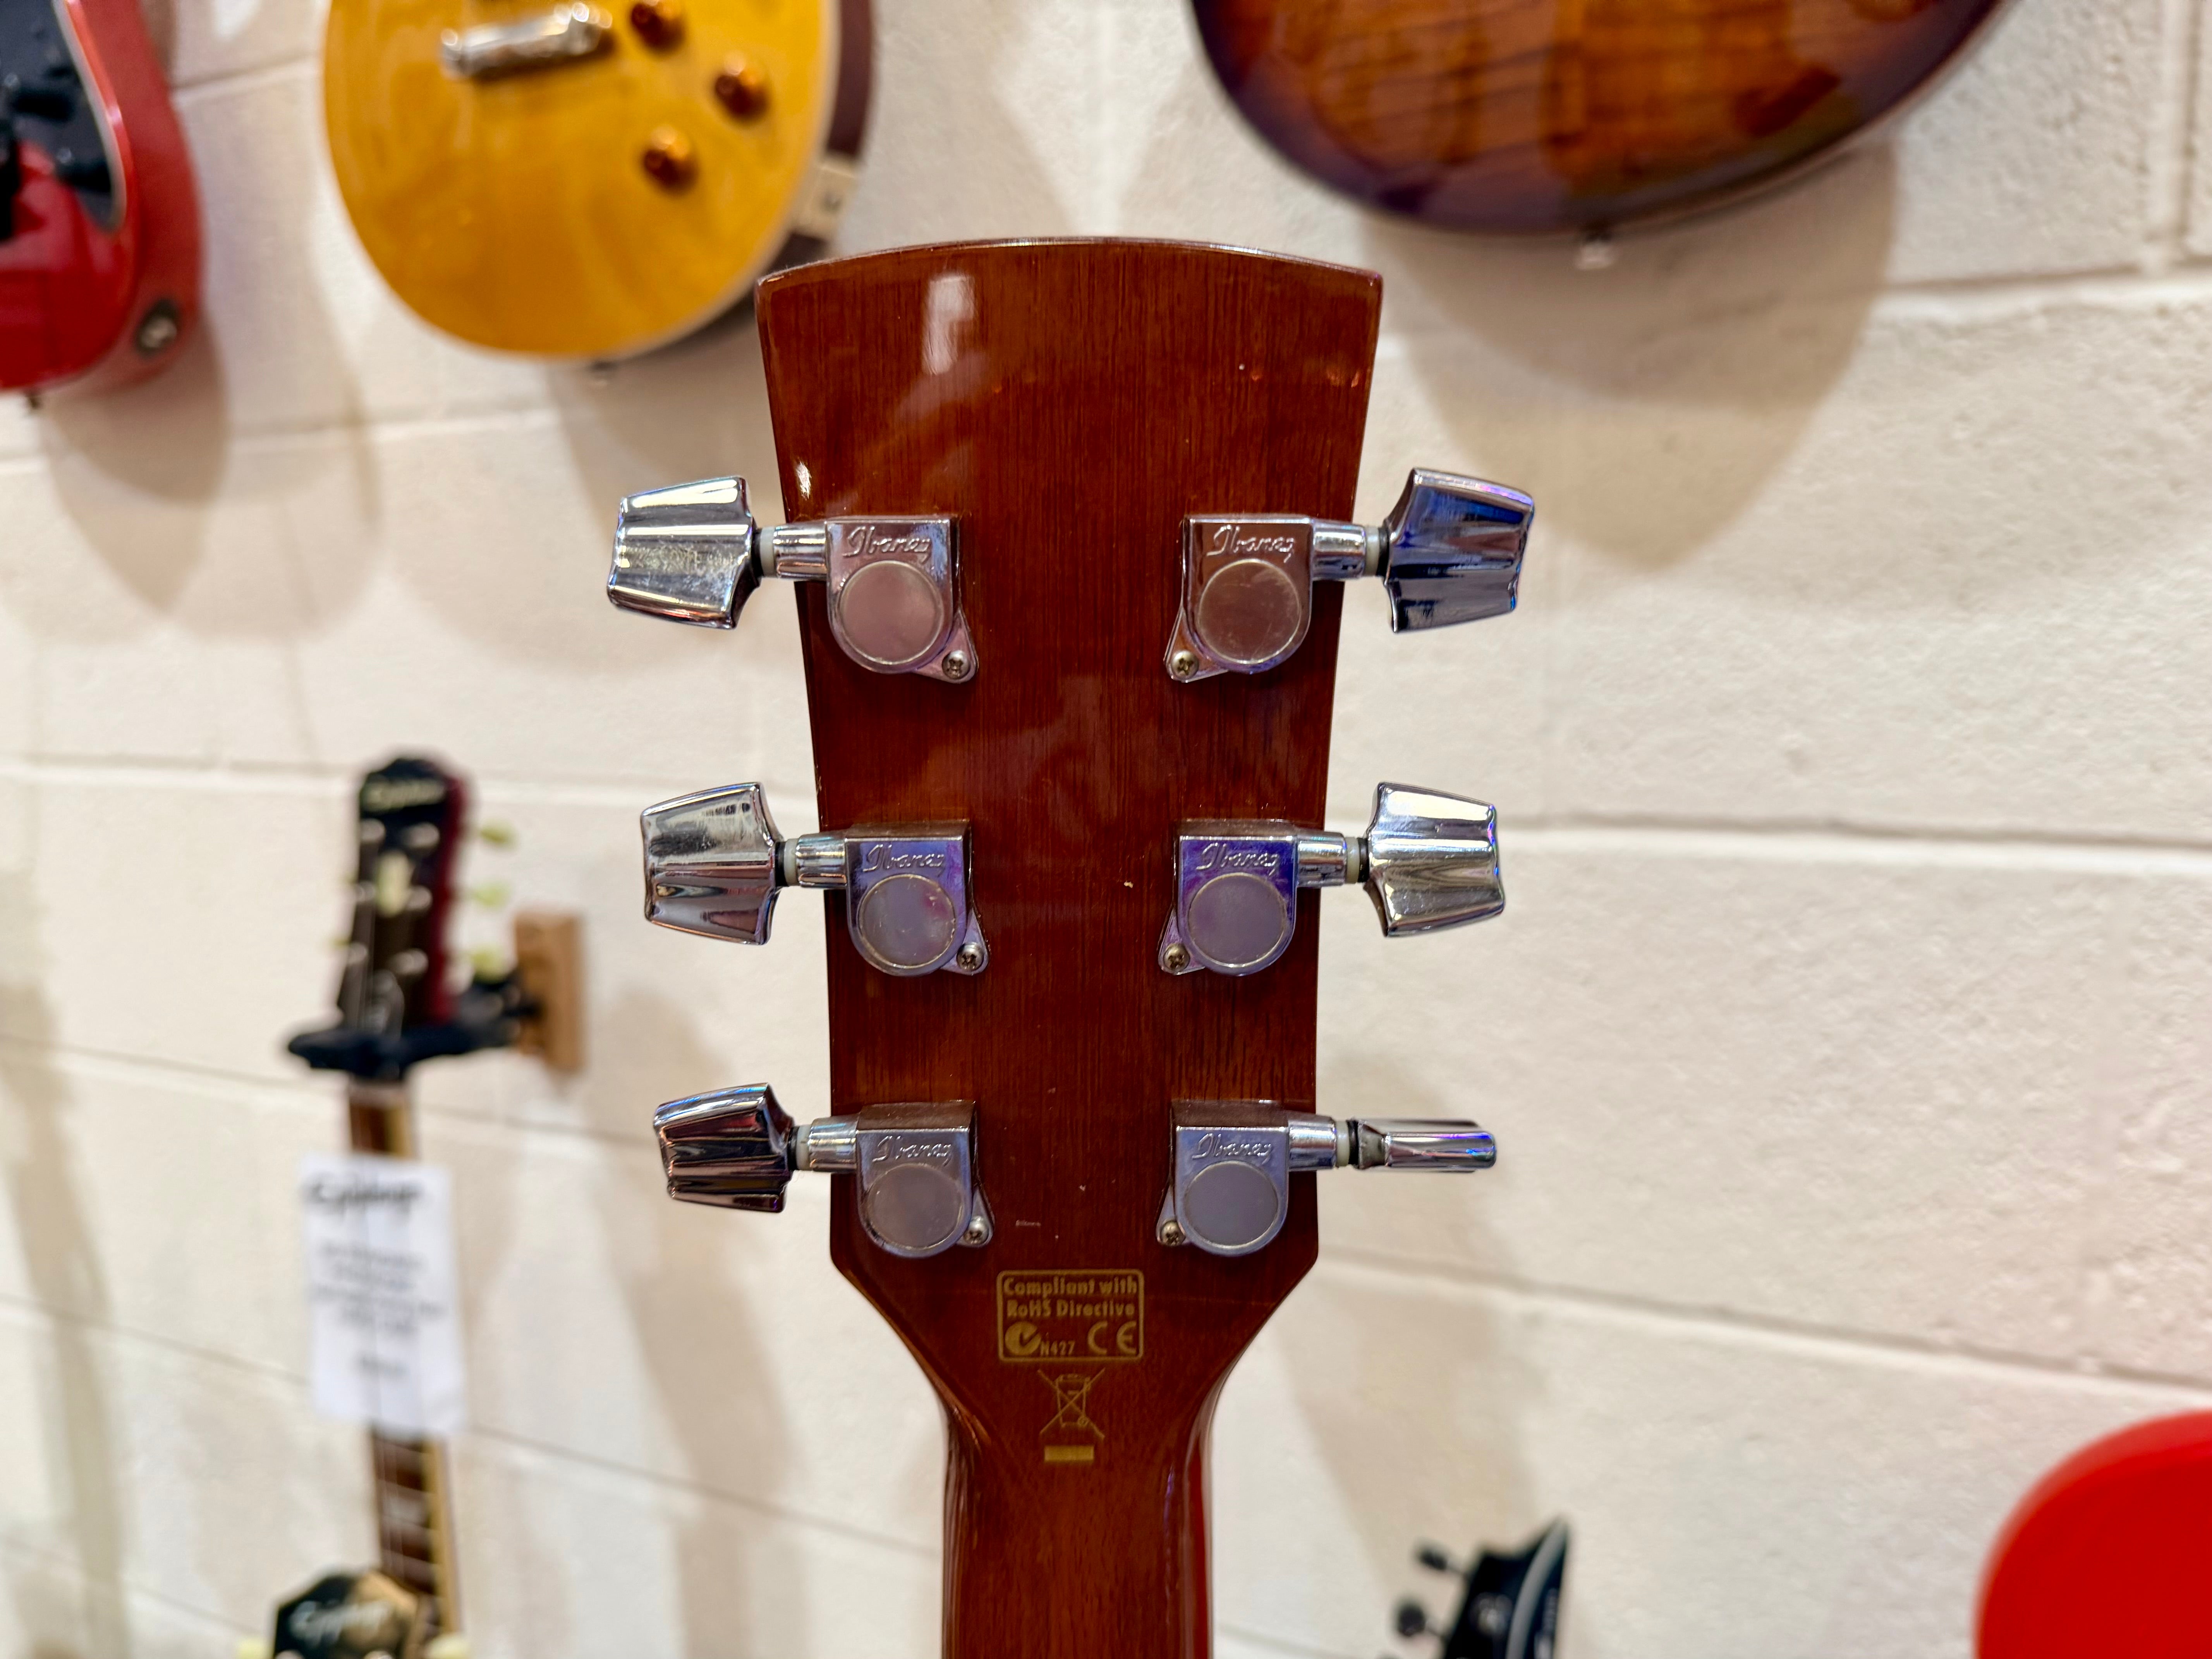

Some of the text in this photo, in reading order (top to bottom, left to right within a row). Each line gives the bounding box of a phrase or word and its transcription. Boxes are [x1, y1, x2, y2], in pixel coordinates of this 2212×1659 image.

[842, 525, 931, 565] Ibanez
[1206, 524, 1295, 563] Ibanez
[862, 844, 945, 877] Ibanez
[1196, 842, 1280, 877] Ibanez
[872, 1135, 953, 1167] Ibanez
[1192, 1133, 1273, 1165] Ibanez
[1003, 1276, 1137, 1298] Compliant with
[1007, 1299, 1135, 1317] RoHS Directive
[1087, 1321, 1137, 1355] CE
